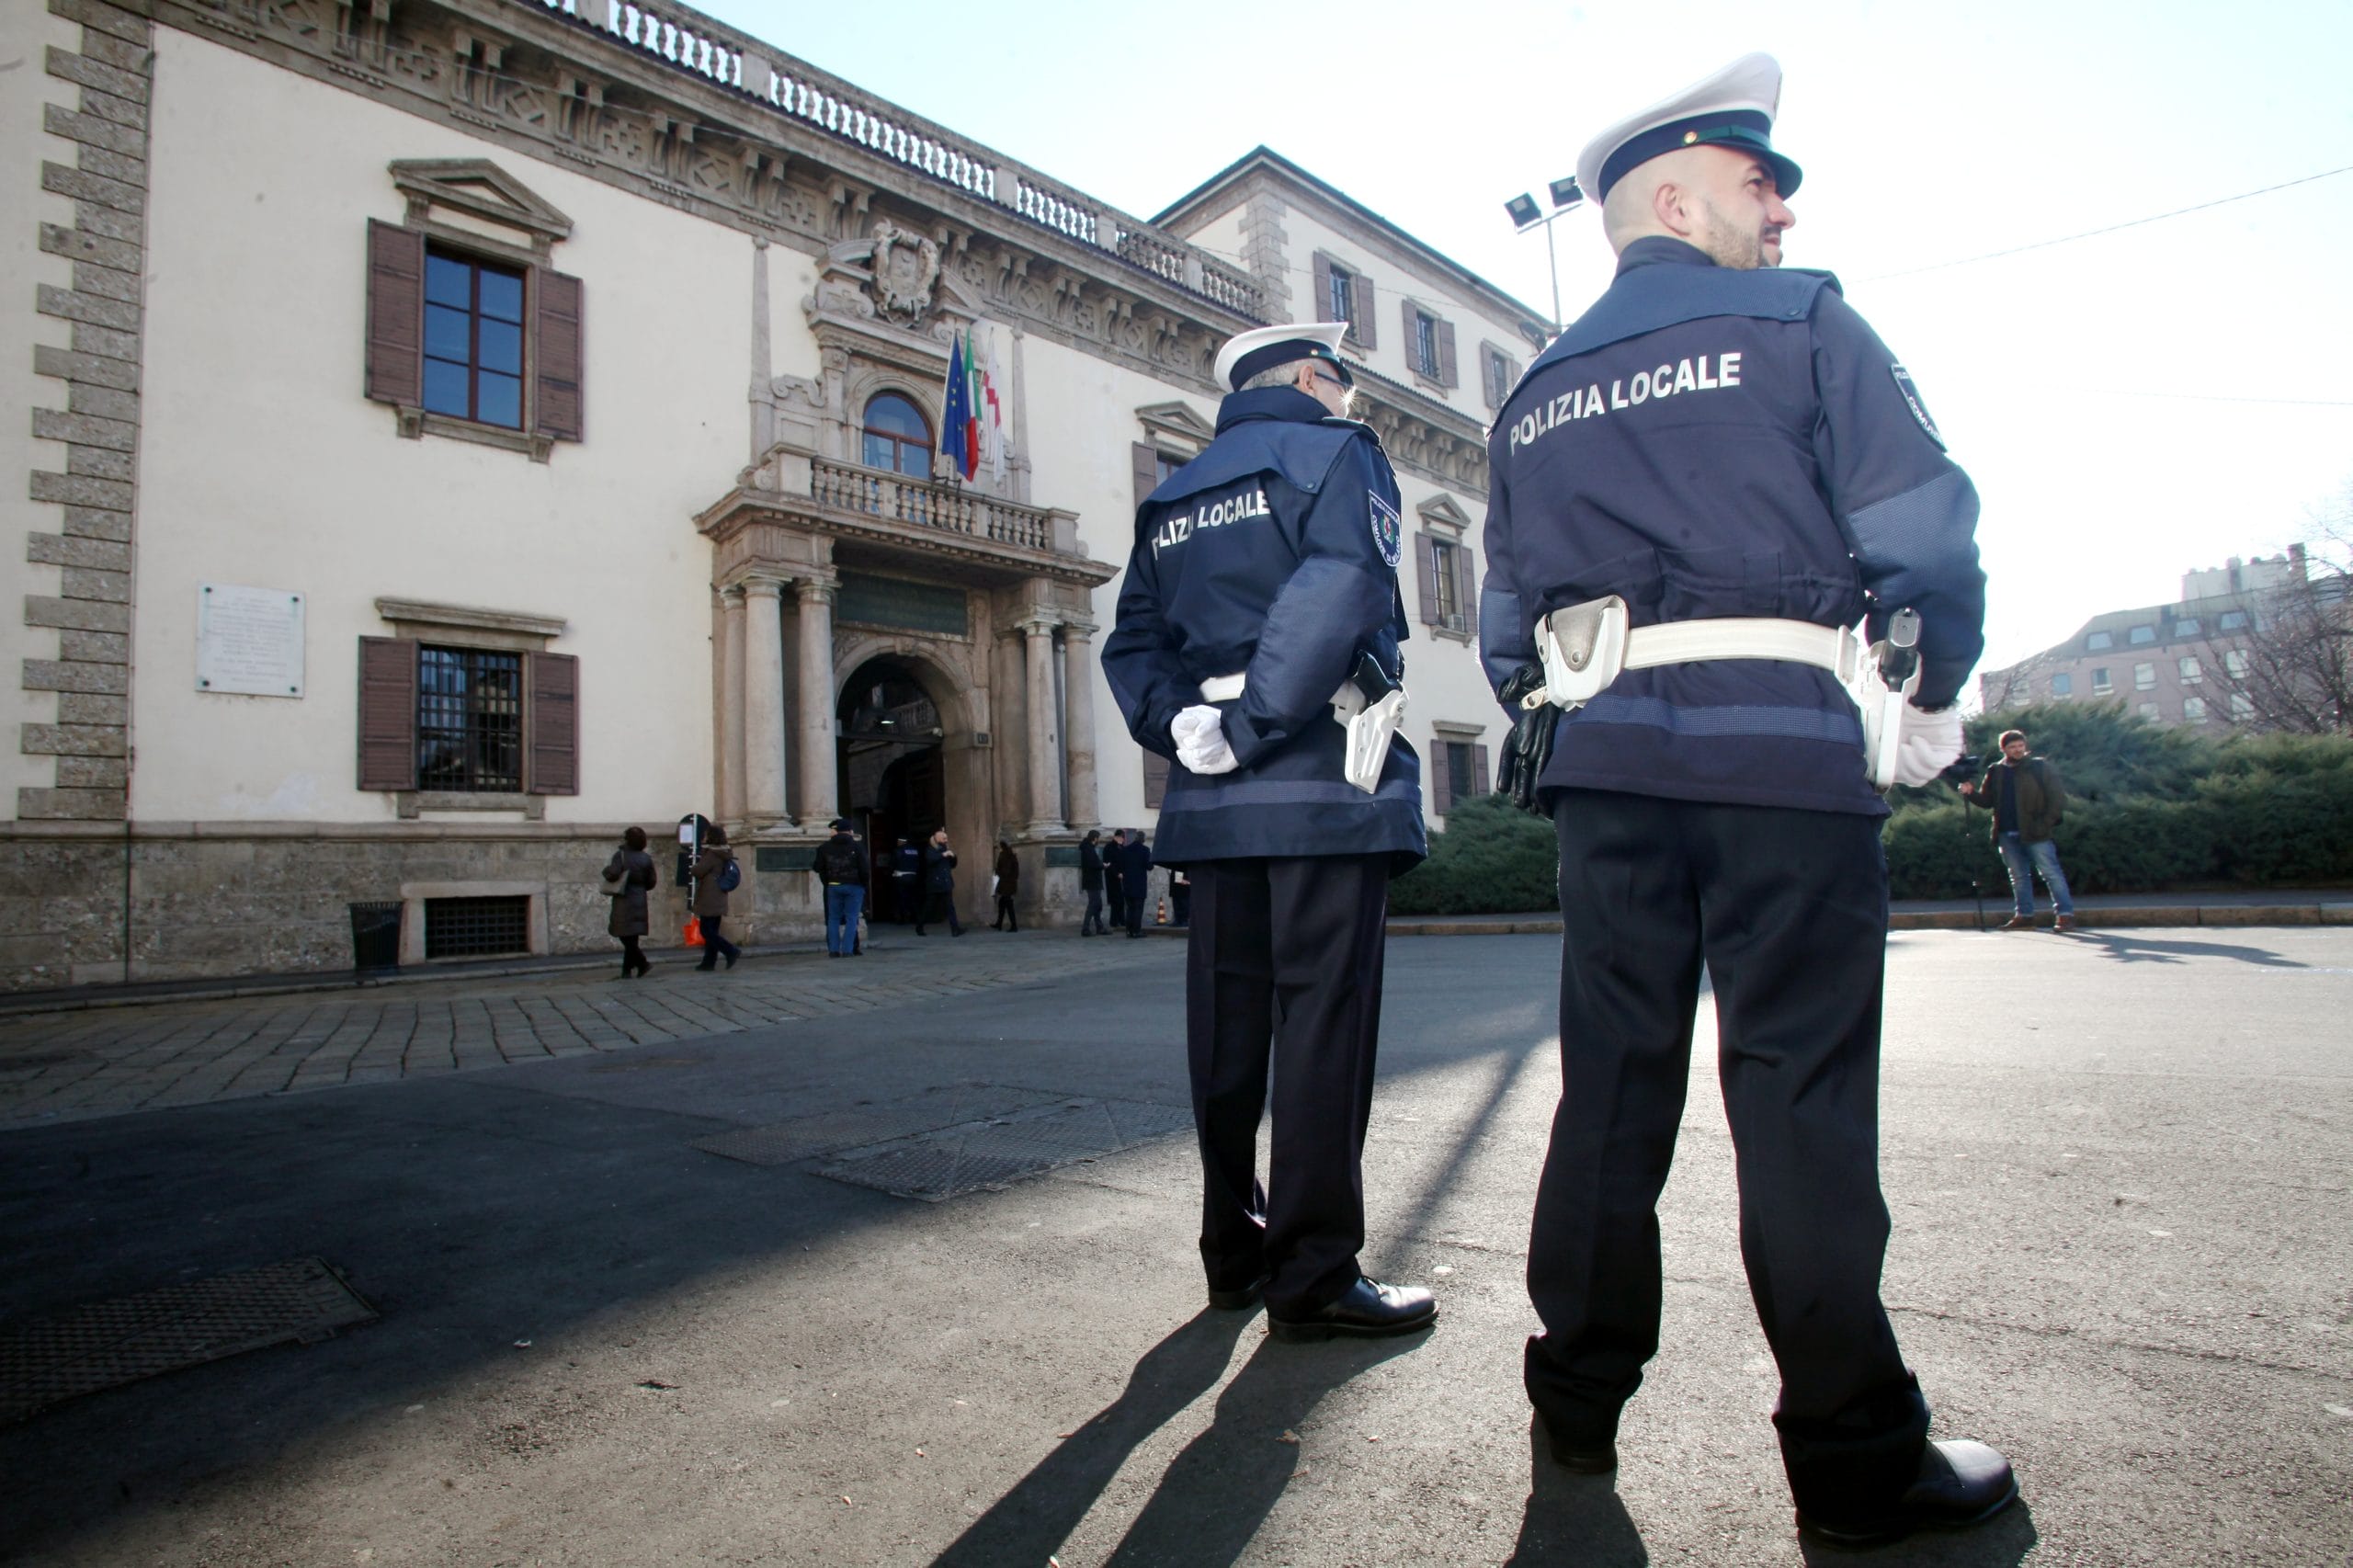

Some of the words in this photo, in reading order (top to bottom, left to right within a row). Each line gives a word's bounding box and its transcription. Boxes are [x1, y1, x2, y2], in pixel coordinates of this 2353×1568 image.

[1509, 383, 1606, 457] POLIZIA
[1610, 352, 1742, 411] LOCALE
[1197, 490, 1271, 528] LOCALE
